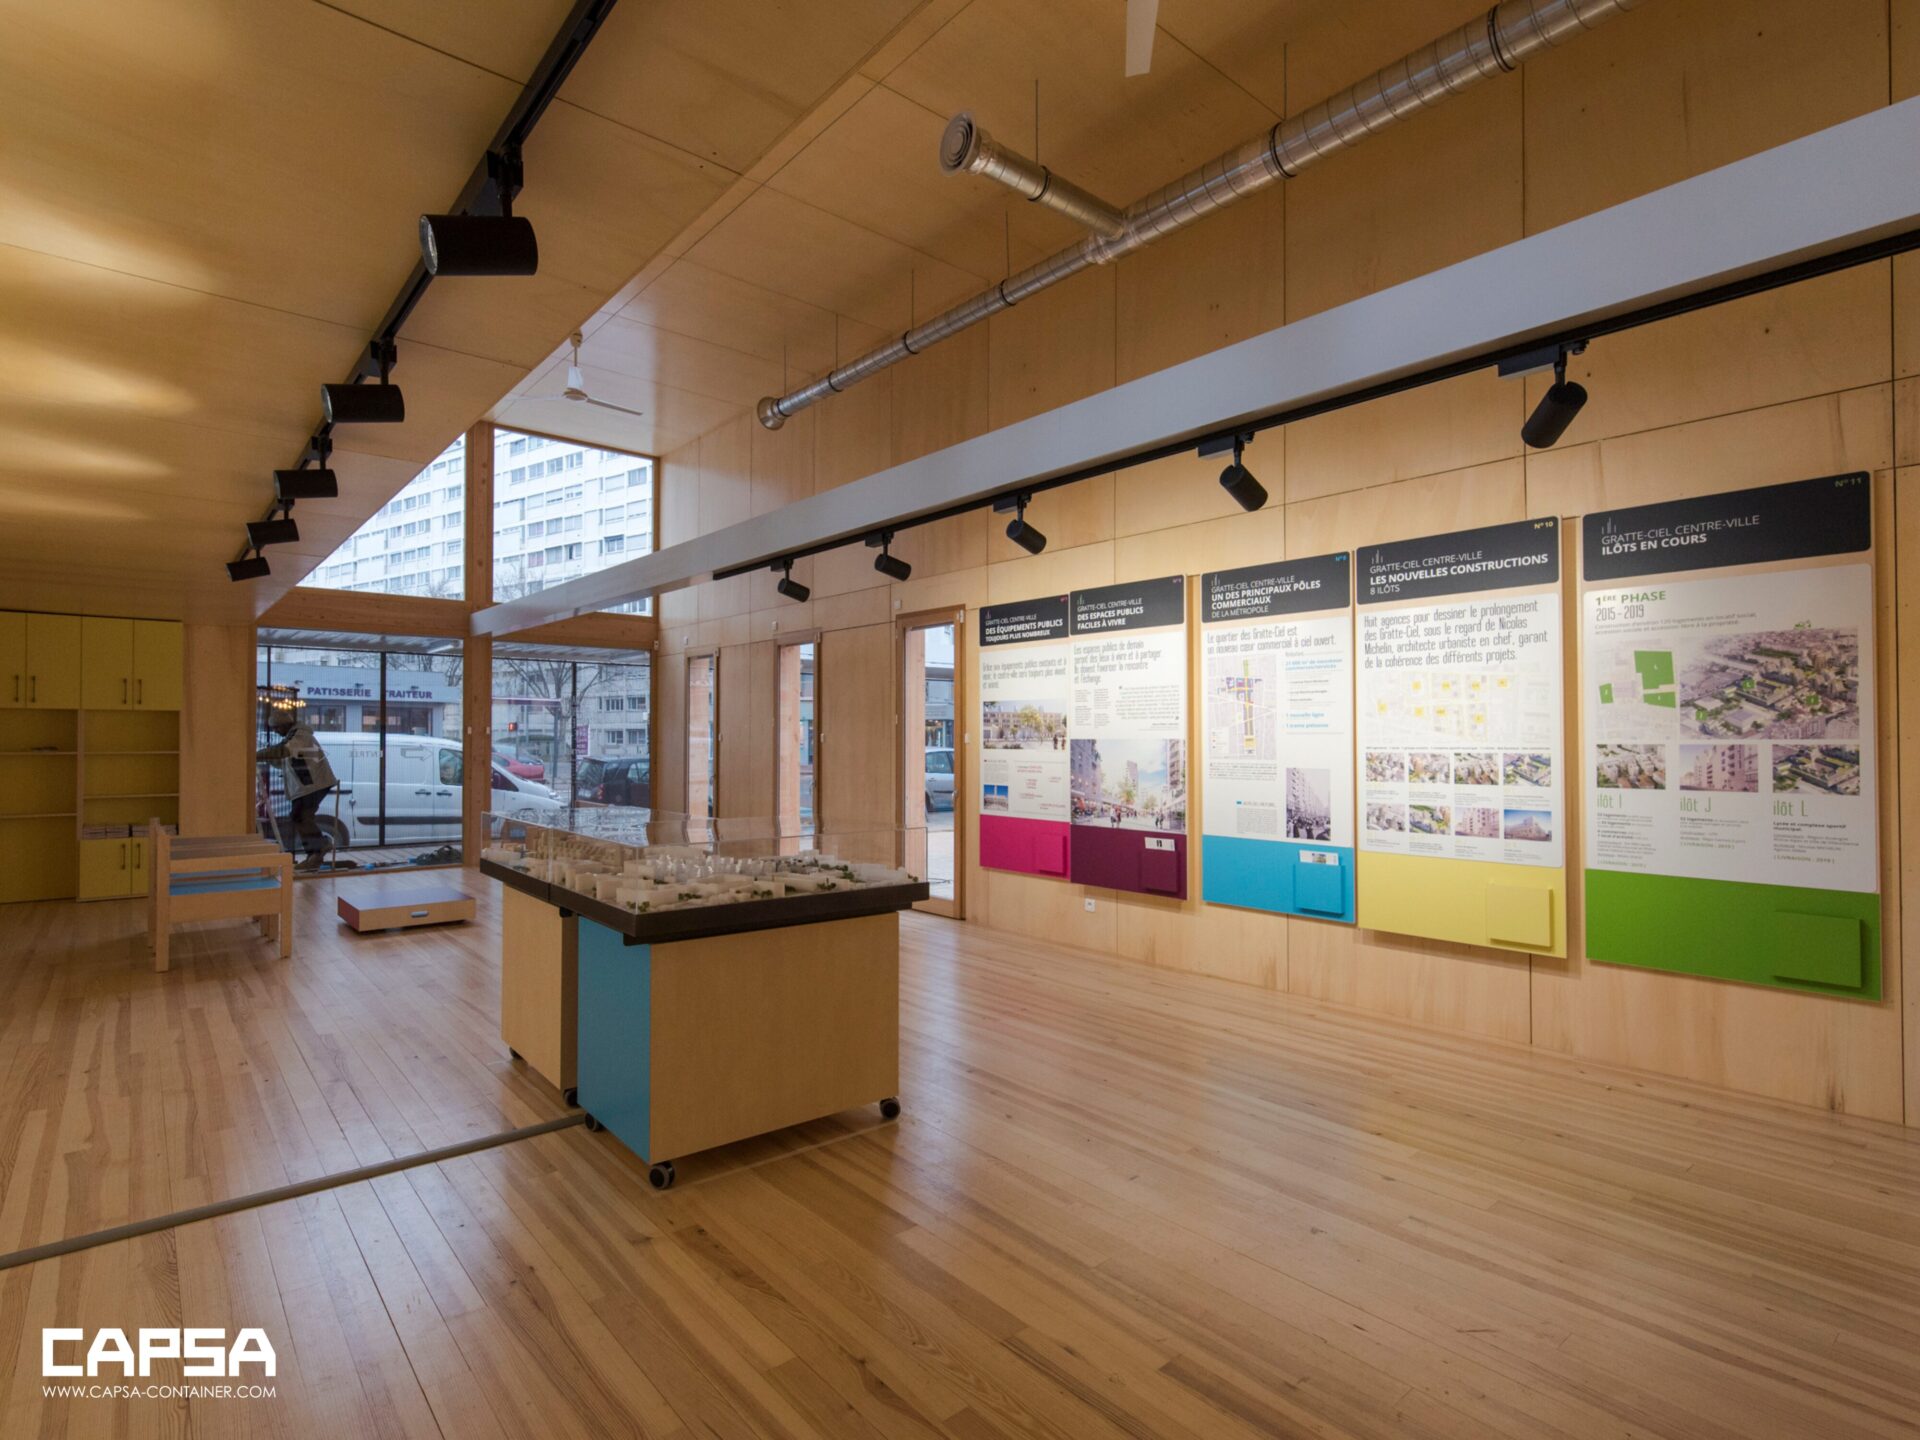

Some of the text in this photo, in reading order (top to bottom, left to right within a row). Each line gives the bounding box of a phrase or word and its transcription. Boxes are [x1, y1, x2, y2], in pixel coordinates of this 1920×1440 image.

[1602, 515, 1760, 546] GRATTE-CIEL CENTRE-VILLE
[1602, 533, 1707, 556] ILÔTS EN COURS
[1370, 551, 1482, 574] GRATTE-CIEL CENTRE-VILLE
[1370, 554, 1548, 586] LES NOUVELLES CONSTRUCTIONS
[1212, 576, 1295, 593] GRATTE-CIEL CENTRE-VILLE
[1225, 592, 1240, 600] DES
[1241, 584, 1291, 598] PRINCIPAUX
[1294, 580, 1320, 592] PÔLES
[1370, 584, 1400, 595] 8 ILÔTS
[1212, 596, 1271, 610] COMMERCIAUX
[1621, 591, 1666, 604] PHASE
[1090, 610, 1115, 620] ESPACES
[1117, 606, 1144, 616] PUBLICS
[1230, 605, 1268, 616] MÉTROPOLE
[1381, 615, 1410, 629] agences
[1413, 613, 1429, 625] pour
[1434, 609, 1466, 621] dessiner
[1470, 605, 1477, 618] le
[1481, 600, 1537, 620] prolongement
[1596, 607, 1616, 621] 2015
[1624, 604, 1644, 619] 2019
[997, 622, 1036, 634] ÉQUIPEMENTS
[1038, 619, 1063, 627] PUBLICS
[1078, 618, 1126, 630] FACILES À VIVRE
[1364, 630, 1376, 641] des
[1424, 626, 1441, 636] sous
[1445, 623, 1452, 633] le
[1454, 620, 1481, 637] regard
[1485, 618, 1495, 631] de
[1499, 616, 1528, 630] Nicolas
[986, 634, 1008, 642] TOUJOURS
[1022, 629, 1051, 638] NOMBREUX
[1300, 636, 1312, 647] ciel
[1397, 640, 1436, 653] architecte
[1439, 637, 1476, 650] urbaniste
[1480, 637, 1489, 647] en
[1518, 630, 1548, 648] garant
[1365, 658, 1373, 668] de
[1376, 656, 1382, 668] la
[1385, 655, 1423, 667] cohérence
[1426, 653, 1439, 665] des
[1443, 651, 1482, 664] différents
[307, 687, 371, 697] PATISSERIE
[1597, 793, 1614, 809] ilôt
[1680, 796, 1711, 812] ilôt J
[1773, 800, 1808, 817] ilôt L
